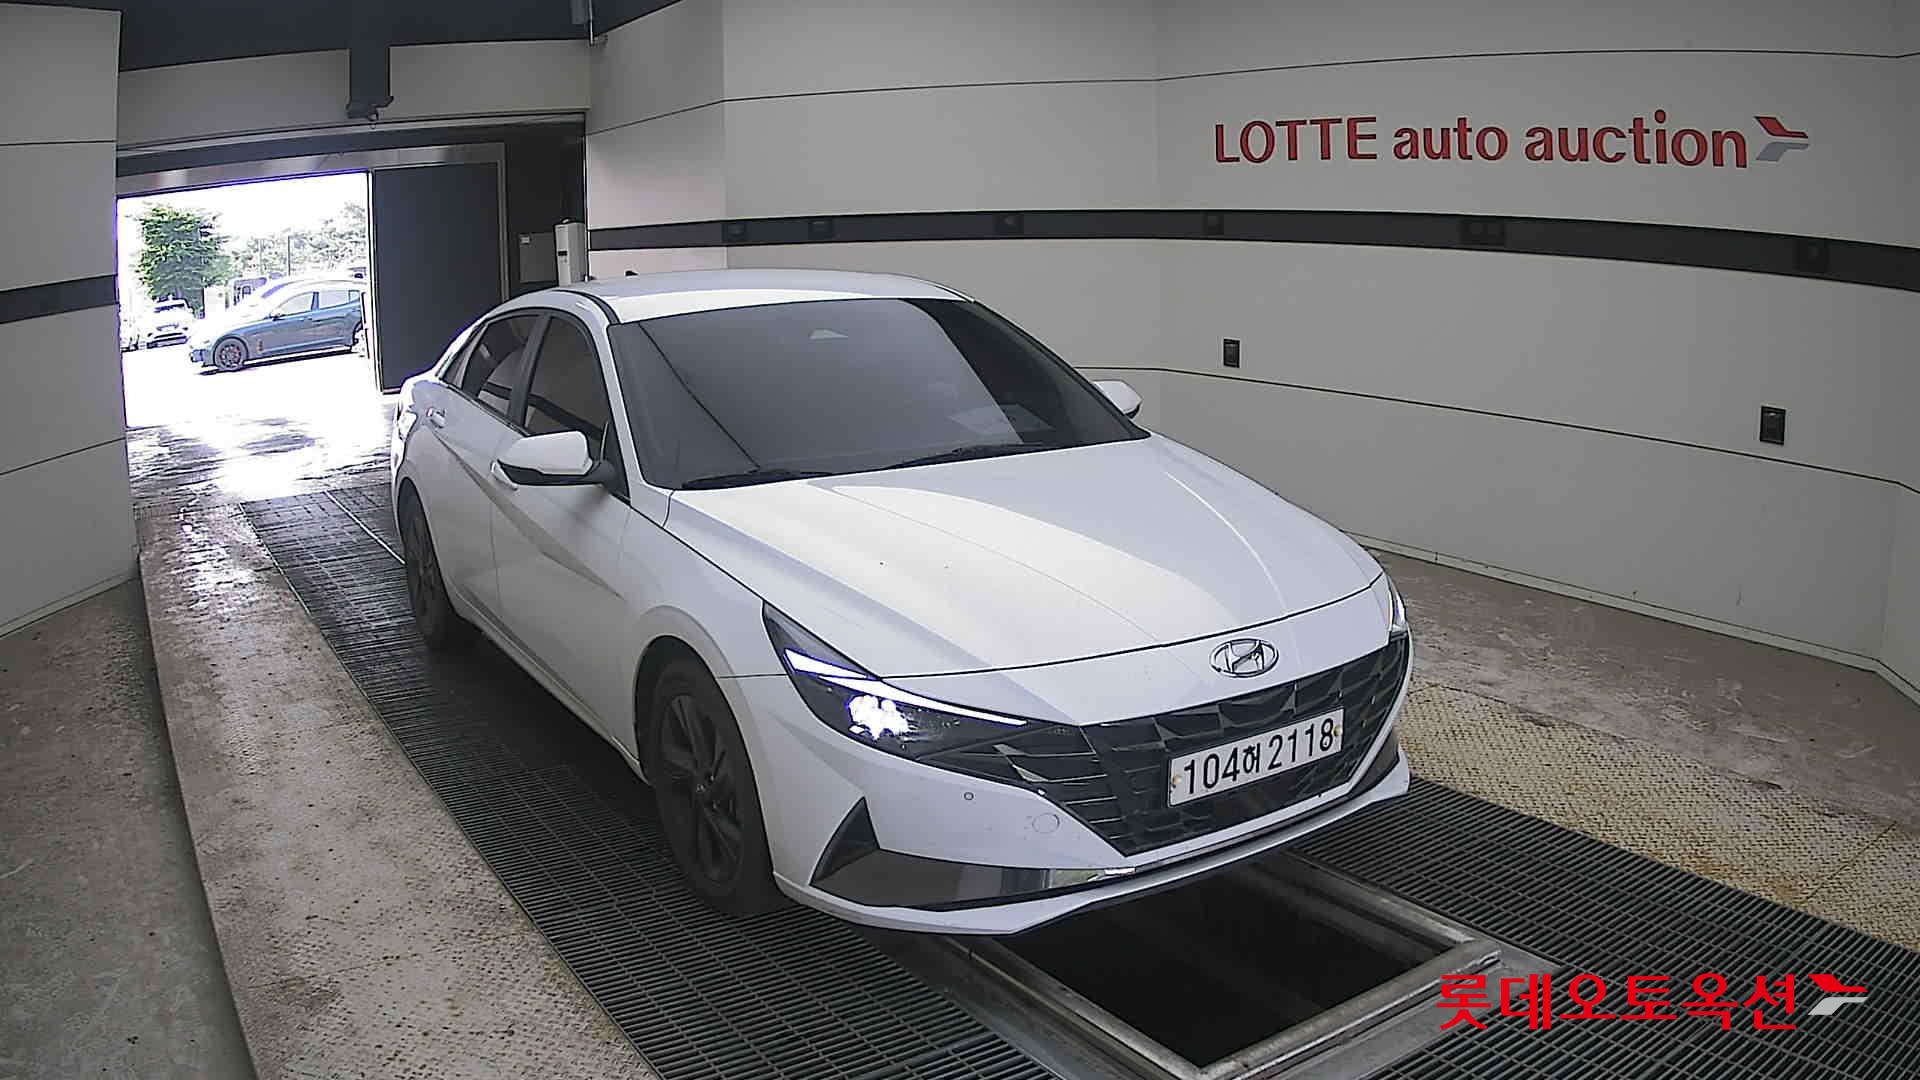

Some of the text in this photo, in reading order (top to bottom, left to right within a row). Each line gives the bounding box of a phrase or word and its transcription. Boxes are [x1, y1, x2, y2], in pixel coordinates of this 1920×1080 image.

[1215, 109, 1748, 169] LOTTE auto auction
